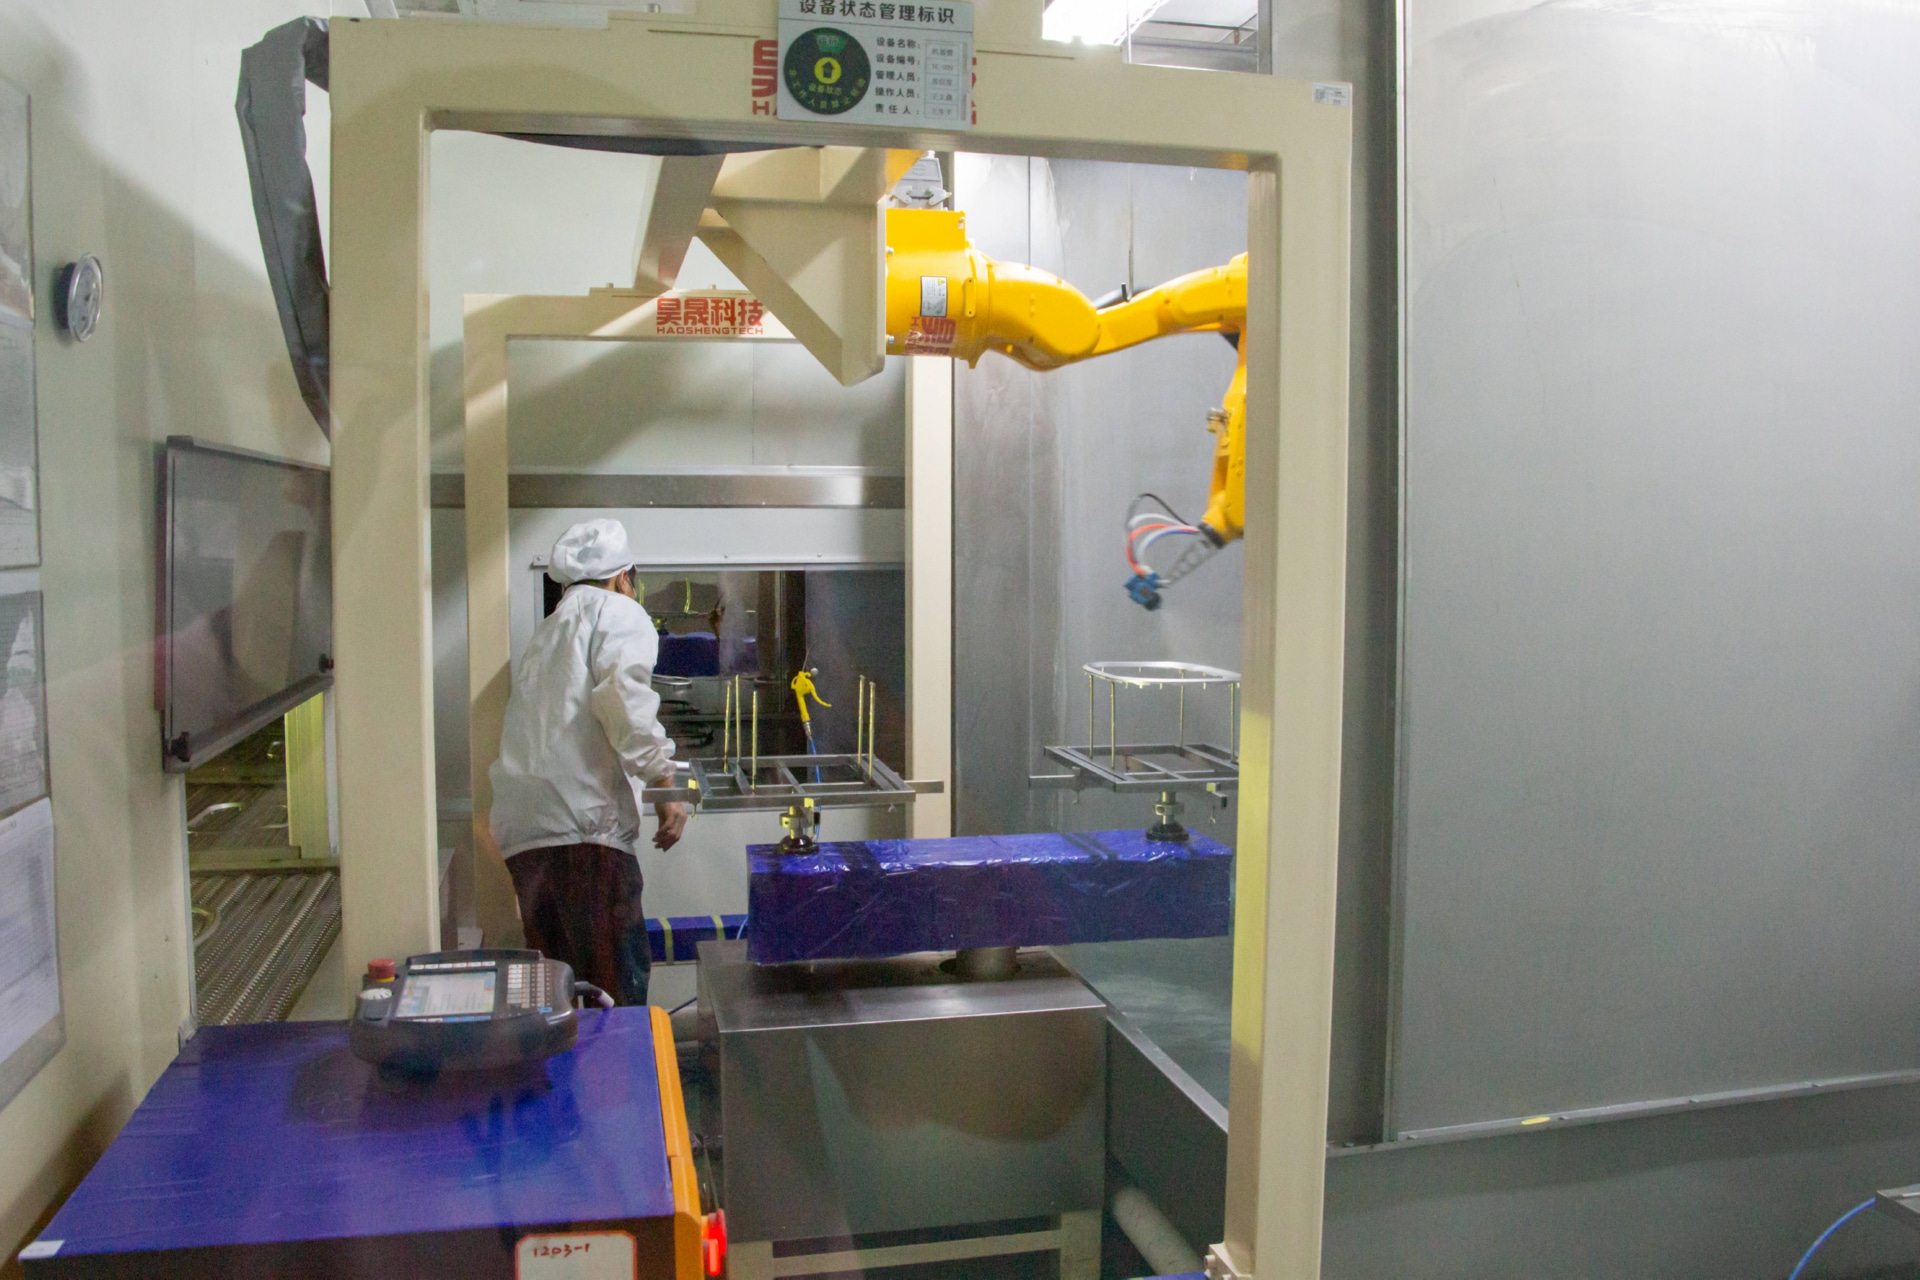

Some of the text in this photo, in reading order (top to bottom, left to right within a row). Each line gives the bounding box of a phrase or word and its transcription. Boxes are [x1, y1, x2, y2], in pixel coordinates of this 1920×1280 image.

[799, 0, 955, 24] 设备状态管理标识
[656, 297, 763, 326] 昊晟科技
[656, 326, 764, 335] HAOSHENGTECH
[533, 1243, 591, 1258] 1203-1
